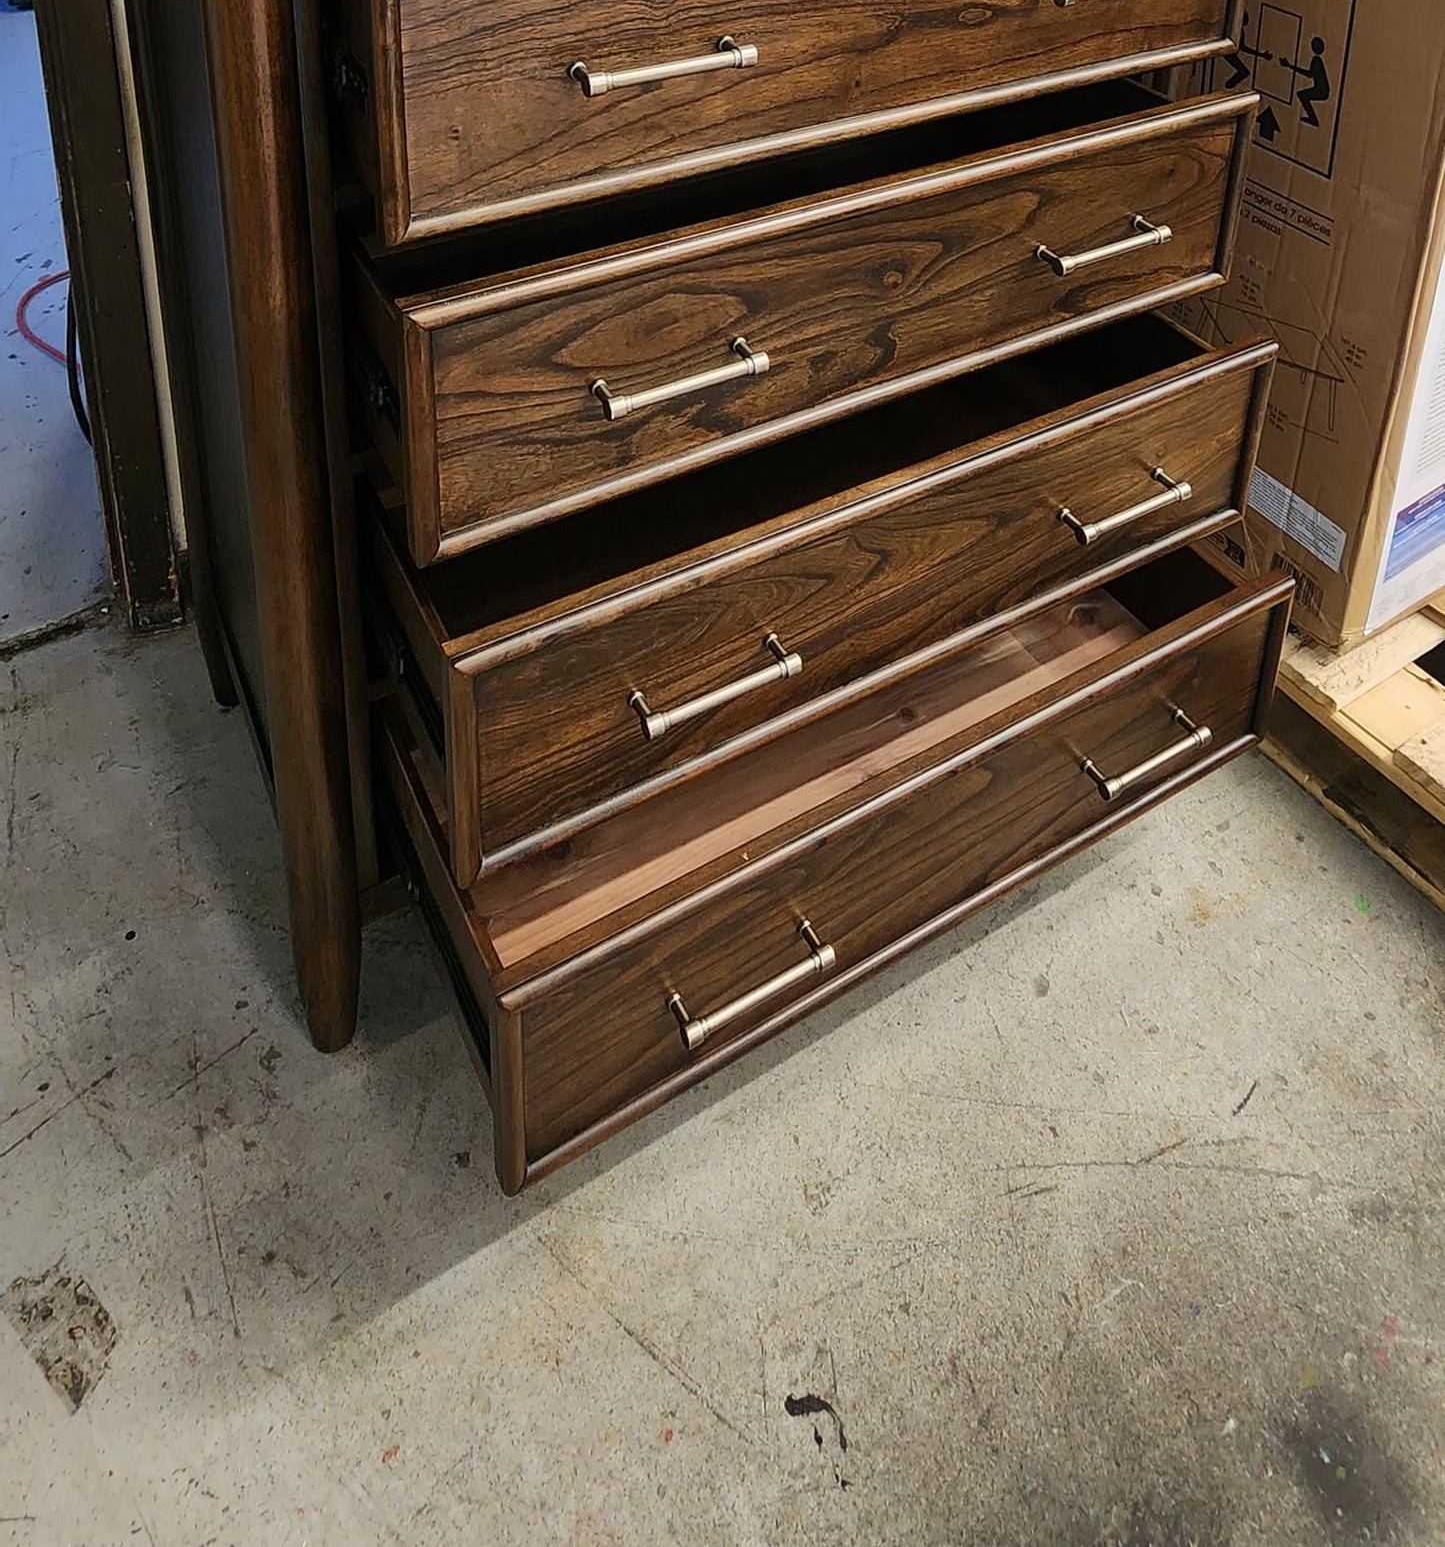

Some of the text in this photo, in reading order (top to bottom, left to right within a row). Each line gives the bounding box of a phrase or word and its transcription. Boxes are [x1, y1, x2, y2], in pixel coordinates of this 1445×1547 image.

[1244, 209, 1281, 236] 7 piezas
[1274, 203, 1288, 214] de
[1289, 208, 1296, 218] 7
[1297, 215, 1331, 237] pièces
